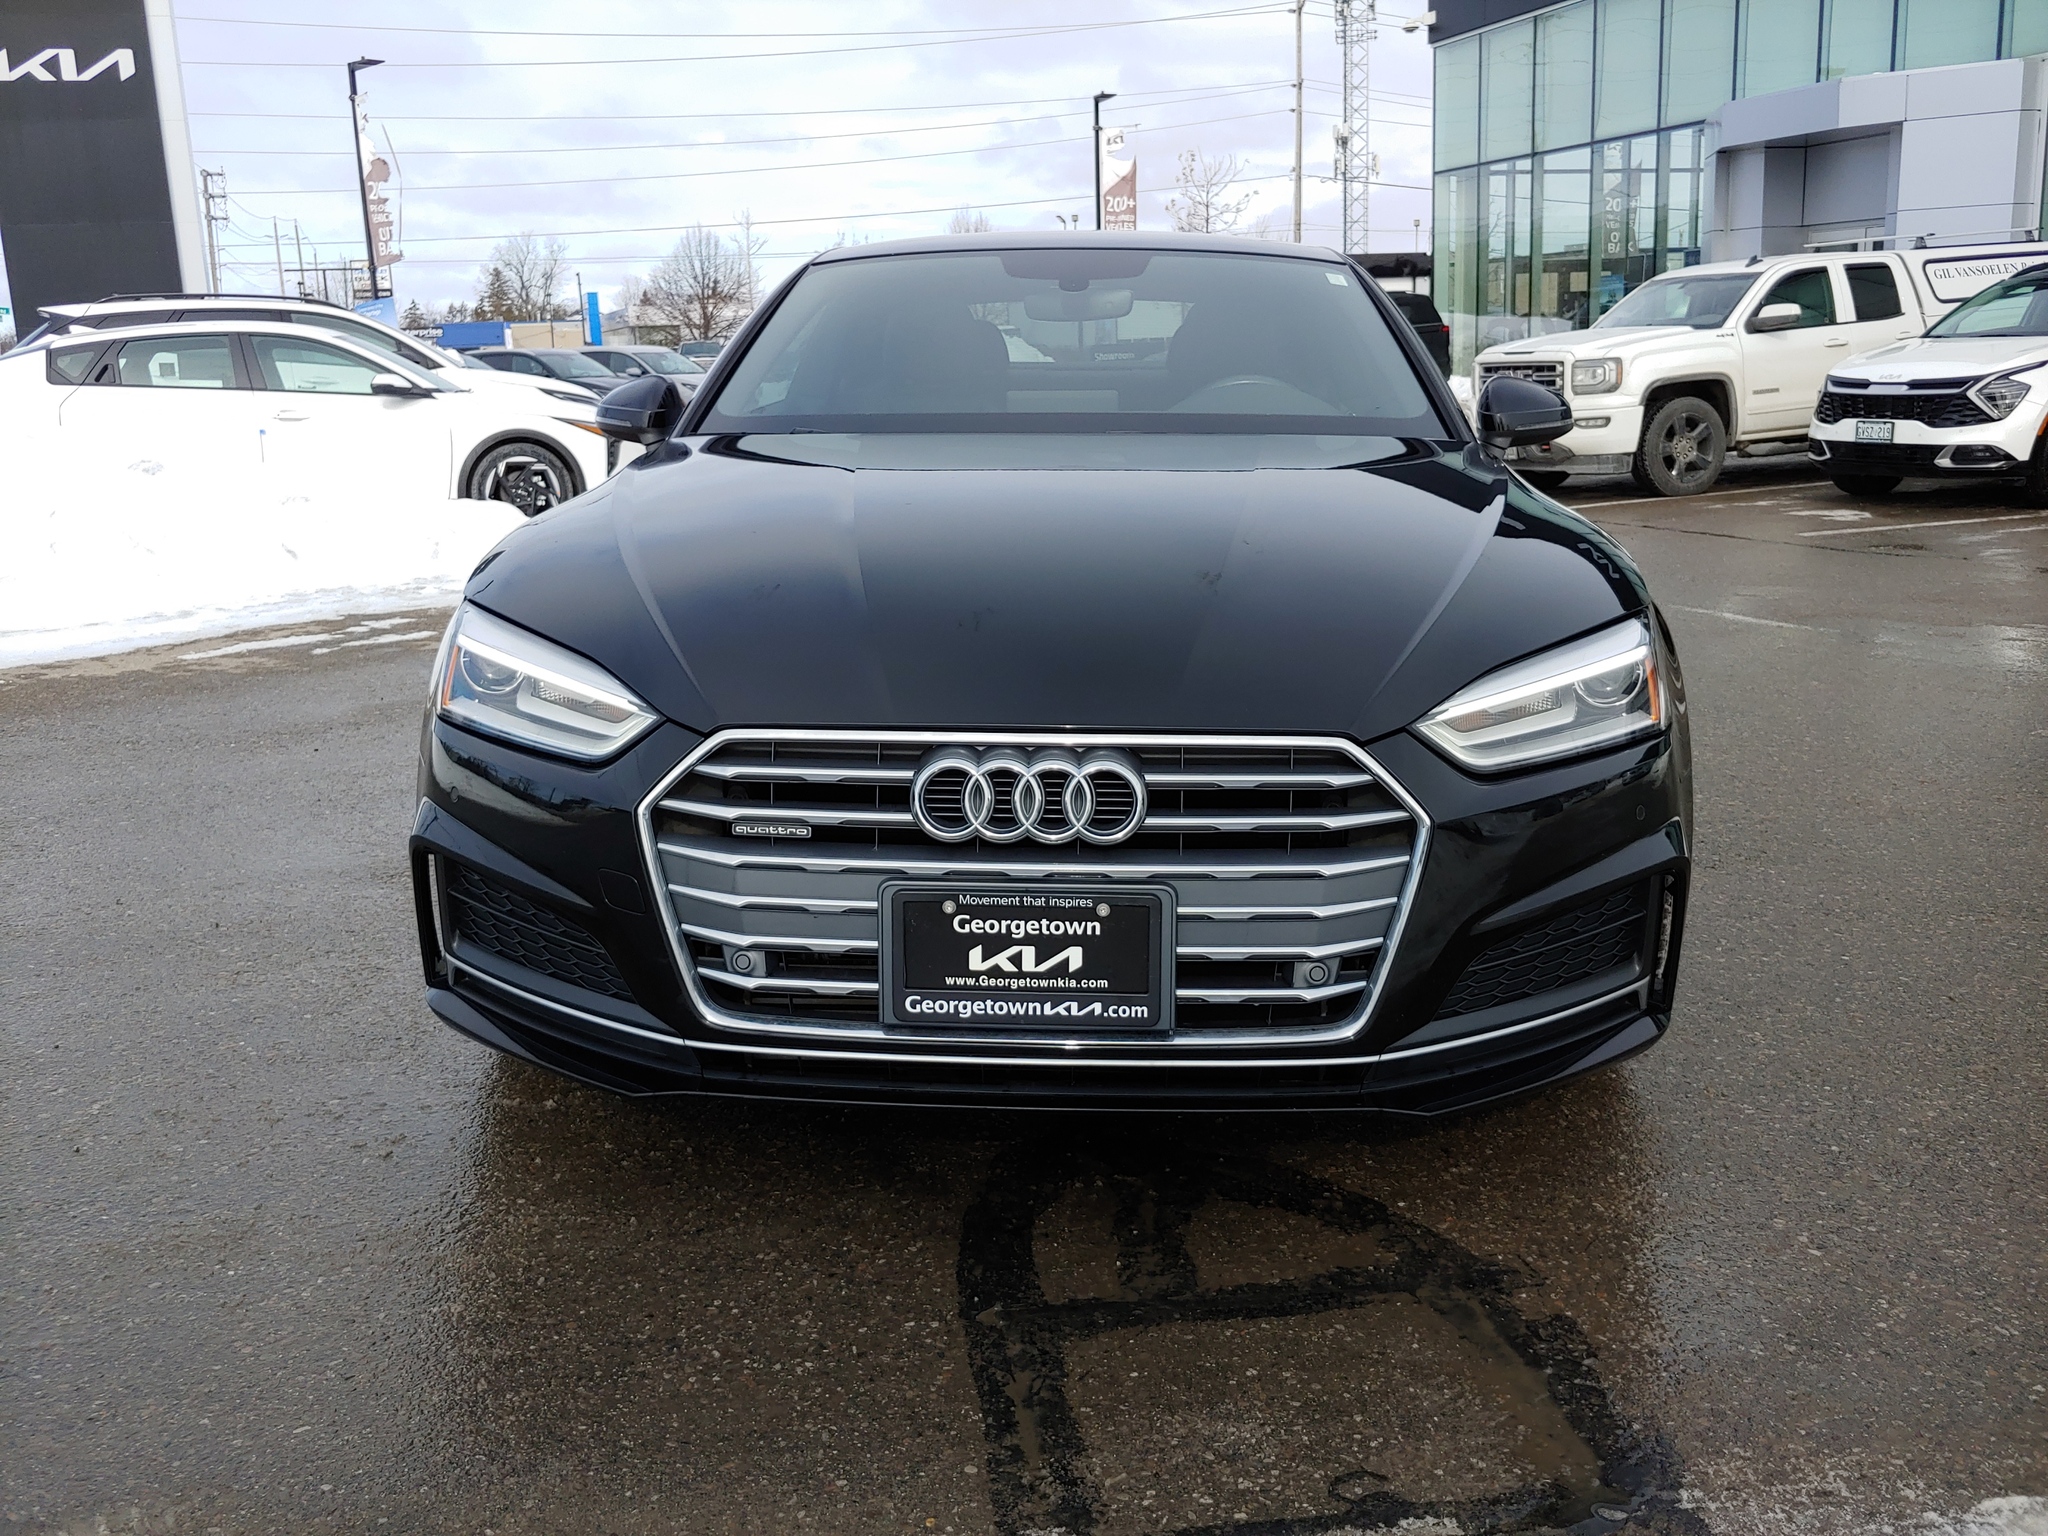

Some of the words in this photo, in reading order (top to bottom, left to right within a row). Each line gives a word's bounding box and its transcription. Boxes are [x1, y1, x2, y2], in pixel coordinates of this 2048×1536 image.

[0, 48, 136, 81] KIA
[1105, 196, 1136, 212] 200+
[1933, 268, 1955, 280] GIL
[1955, 263, 2019, 278] VANSOELEN
[1094, 353, 1136, 361] Showroom
[735, 826, 808, 835] quattro
[958, 894, 1019, 906] Movement
[1023, 895, 1046, 906] that
[1049, 896, 1093, 908] inspires
[952, 914, 1101, 939] Georgetown
[968, 944, 1083, 974] KIA
[945, 975, 1109, 989] www.Georgetownkia.com
